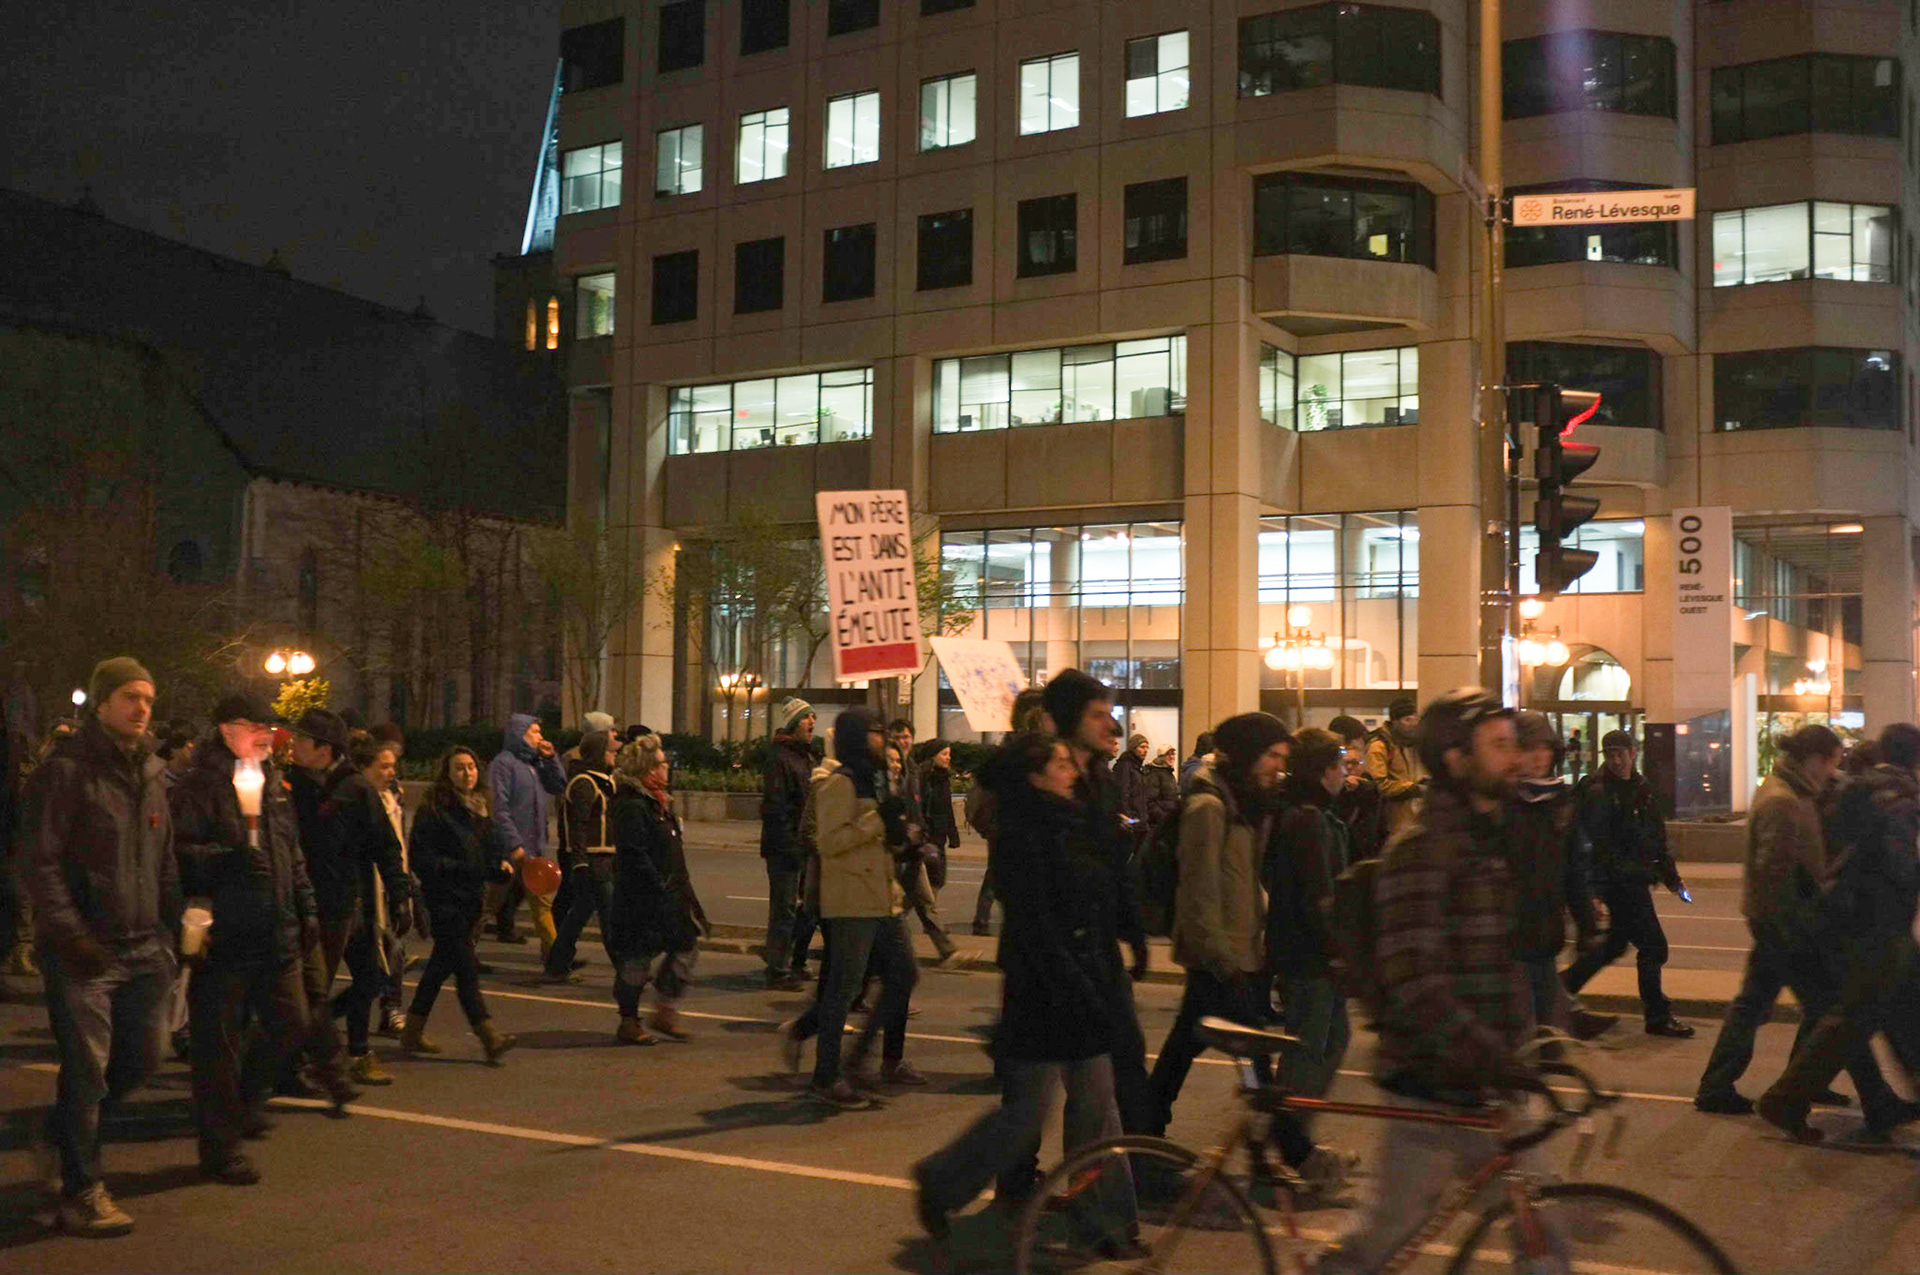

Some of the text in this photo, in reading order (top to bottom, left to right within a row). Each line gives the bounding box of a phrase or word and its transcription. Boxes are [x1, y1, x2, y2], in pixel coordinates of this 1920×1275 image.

[1553, 203, 1681, 220] René-Lévesque
[829, 495, 904, 525] MON PÈRE
[832, 533, 908, 561] EST DANS
[1679, 515, 1702, 574] 500
[839, 568, 912, 604] L'ANTI-
[838, 608, 913, 646] ÉMEUTE
